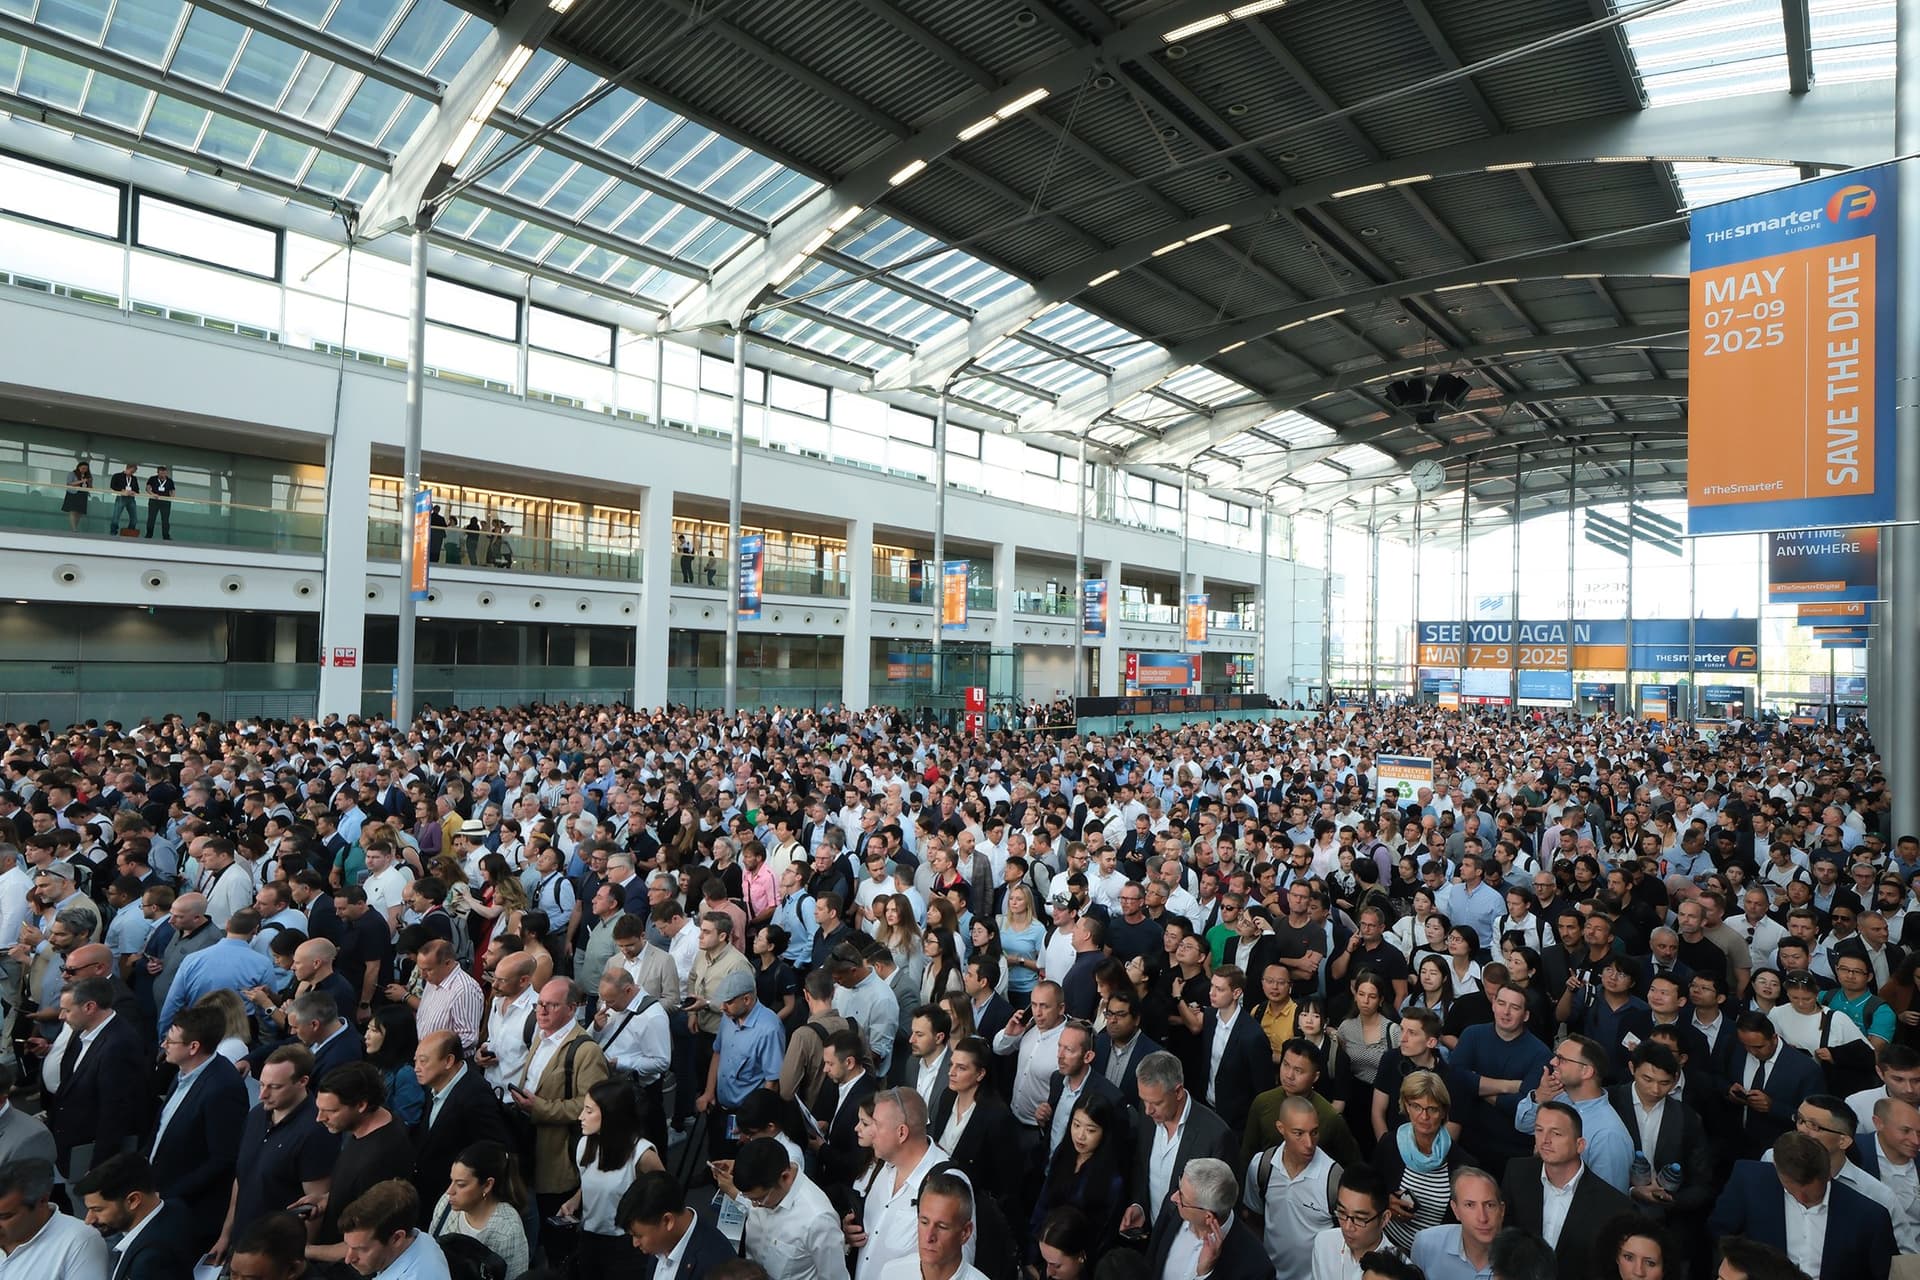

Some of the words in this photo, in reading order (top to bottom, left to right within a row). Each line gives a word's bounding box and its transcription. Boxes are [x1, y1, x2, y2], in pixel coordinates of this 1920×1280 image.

[1784, 222, 1822, 236] EUROPE
[1704, 266, 1786, 306] MAY
[1828, 252, 1860, 333] DATE
[1703, 323, 1785, 357] 2025
[1827, 337, 1859, 401] THE
[1826, 406, 1859, 485] SAVE
[1703, 479, 1784, 496] #TheSmarterE
[1776, 542, 1861, 557] ANYWHERE
[1426, 624, 1461, 642] SEE
[1469, 624, 1513, 642] YOU
[1518, 624, 1591, 642] AGAN
[1426, 647, 1465, 663] MAY
[1520, 648, 1568, 665] 2025
